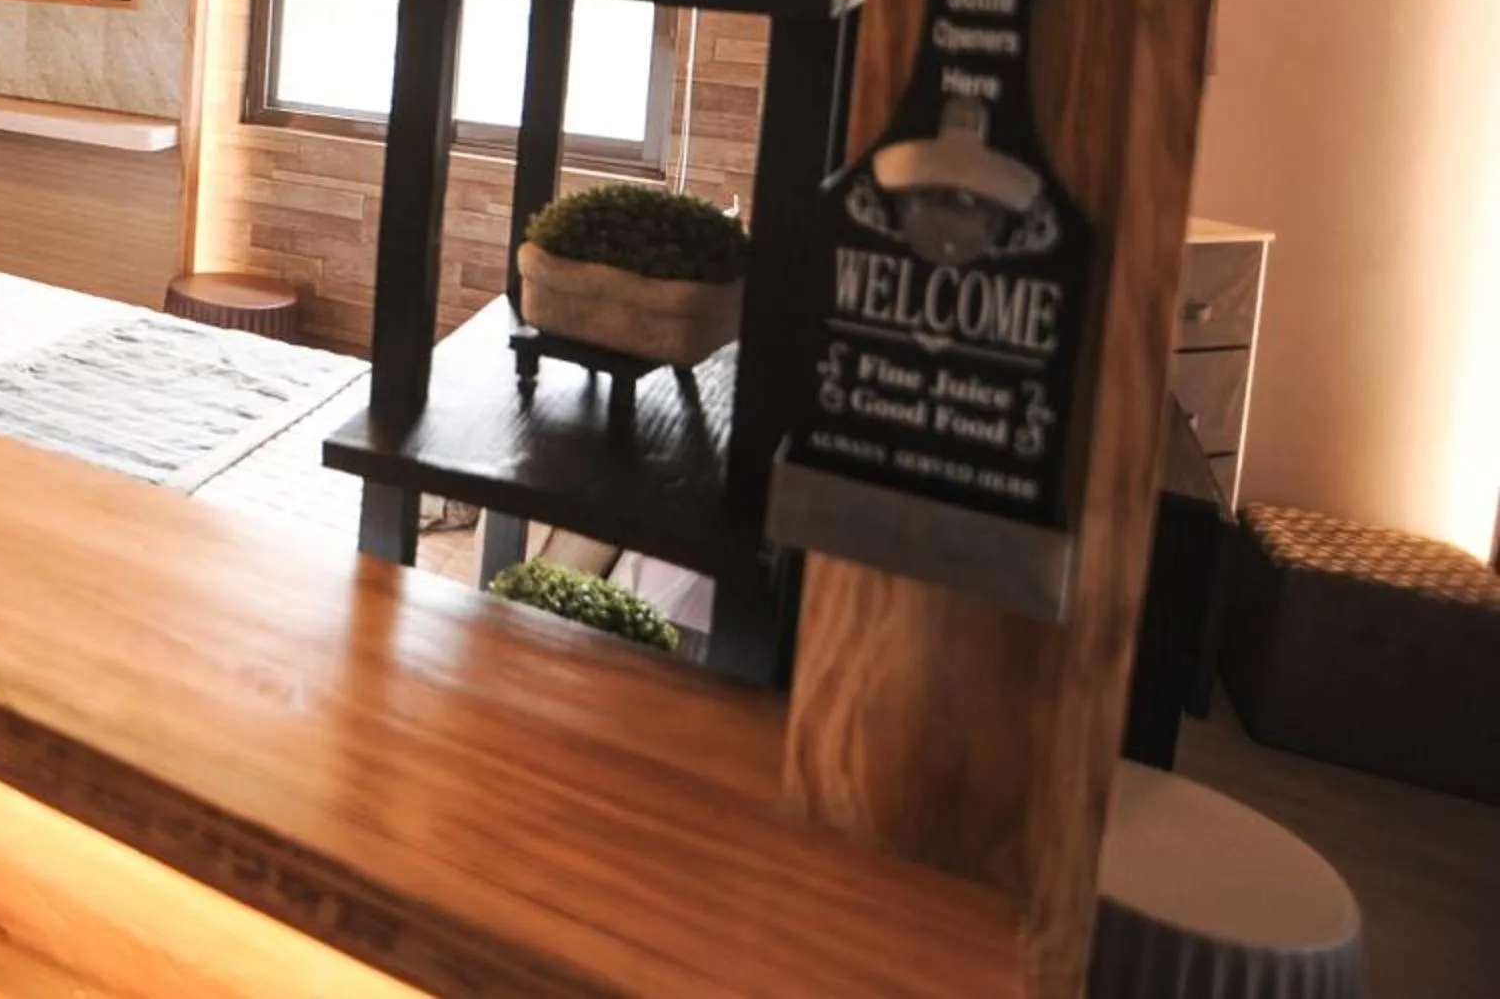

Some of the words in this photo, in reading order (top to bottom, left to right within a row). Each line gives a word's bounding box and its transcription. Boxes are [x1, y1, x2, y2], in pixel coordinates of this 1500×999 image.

[941, 67, 1000, 99] Here
[835, 248, 1062, 352] WELCOME
[858, 353, 922, 389] Fine
[929, 370, 1011, 407] Juice
[850, 387, 926, 427] Good
[934, 405, 1008, 445] Food
